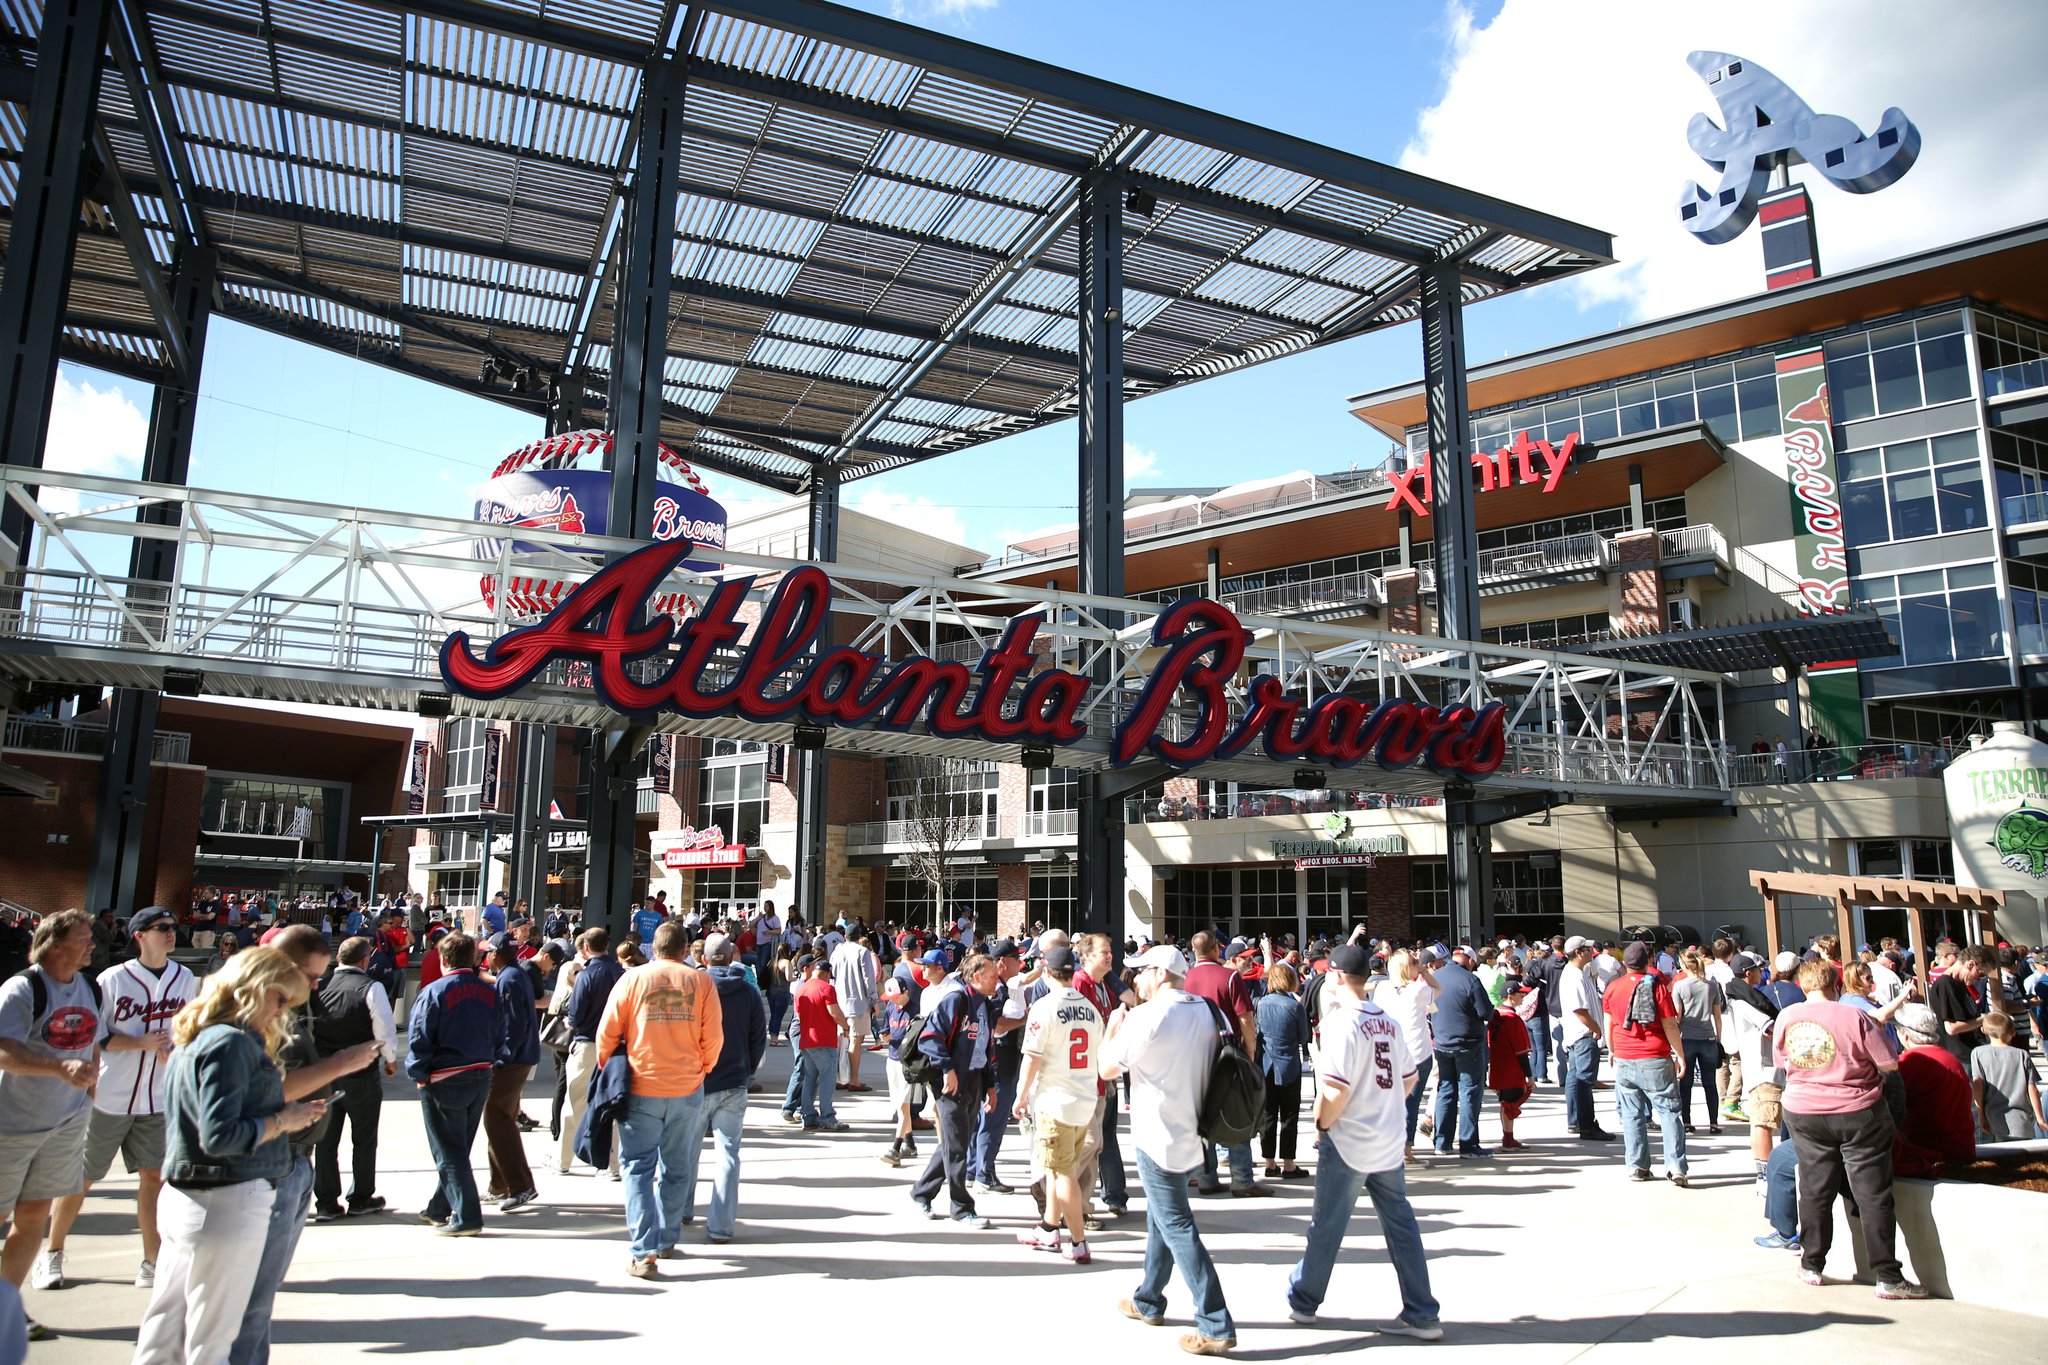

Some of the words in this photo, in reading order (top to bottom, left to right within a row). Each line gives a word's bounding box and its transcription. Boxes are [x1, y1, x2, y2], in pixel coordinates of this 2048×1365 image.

[1385, 430, 1579, 517] xfnity
[652, 497, 726, 540] Braves
[439, 540, 1092, 746] Atlanta
[1110, 599, 1507, 781] Braves
[655, 734, 671, 770] Bra
[410, 754, 425, 798] Braves
[566, 831, 588, 847] GAT
[1269, 839, 1334, 857] TERRAPIN
[1339, 834, 1404, 854] TAPROOM
[667, 850, 711, 866] CLUBHOUSE
[713, 849, 740, 864] STORE
[1322, 856, 1342, 865] BROS.
[1343, 855, 1371, 864] BAR-B-Q
[114, 996, 186, 1023] Braves
[1057, 1006, 1095, 1025] SWANSON
[1360, 1018, 1396, 1041] FREEMAN
[1069, 1028, 1089, 1070] 2
[1374, 1040, 1393, 1090] 5
